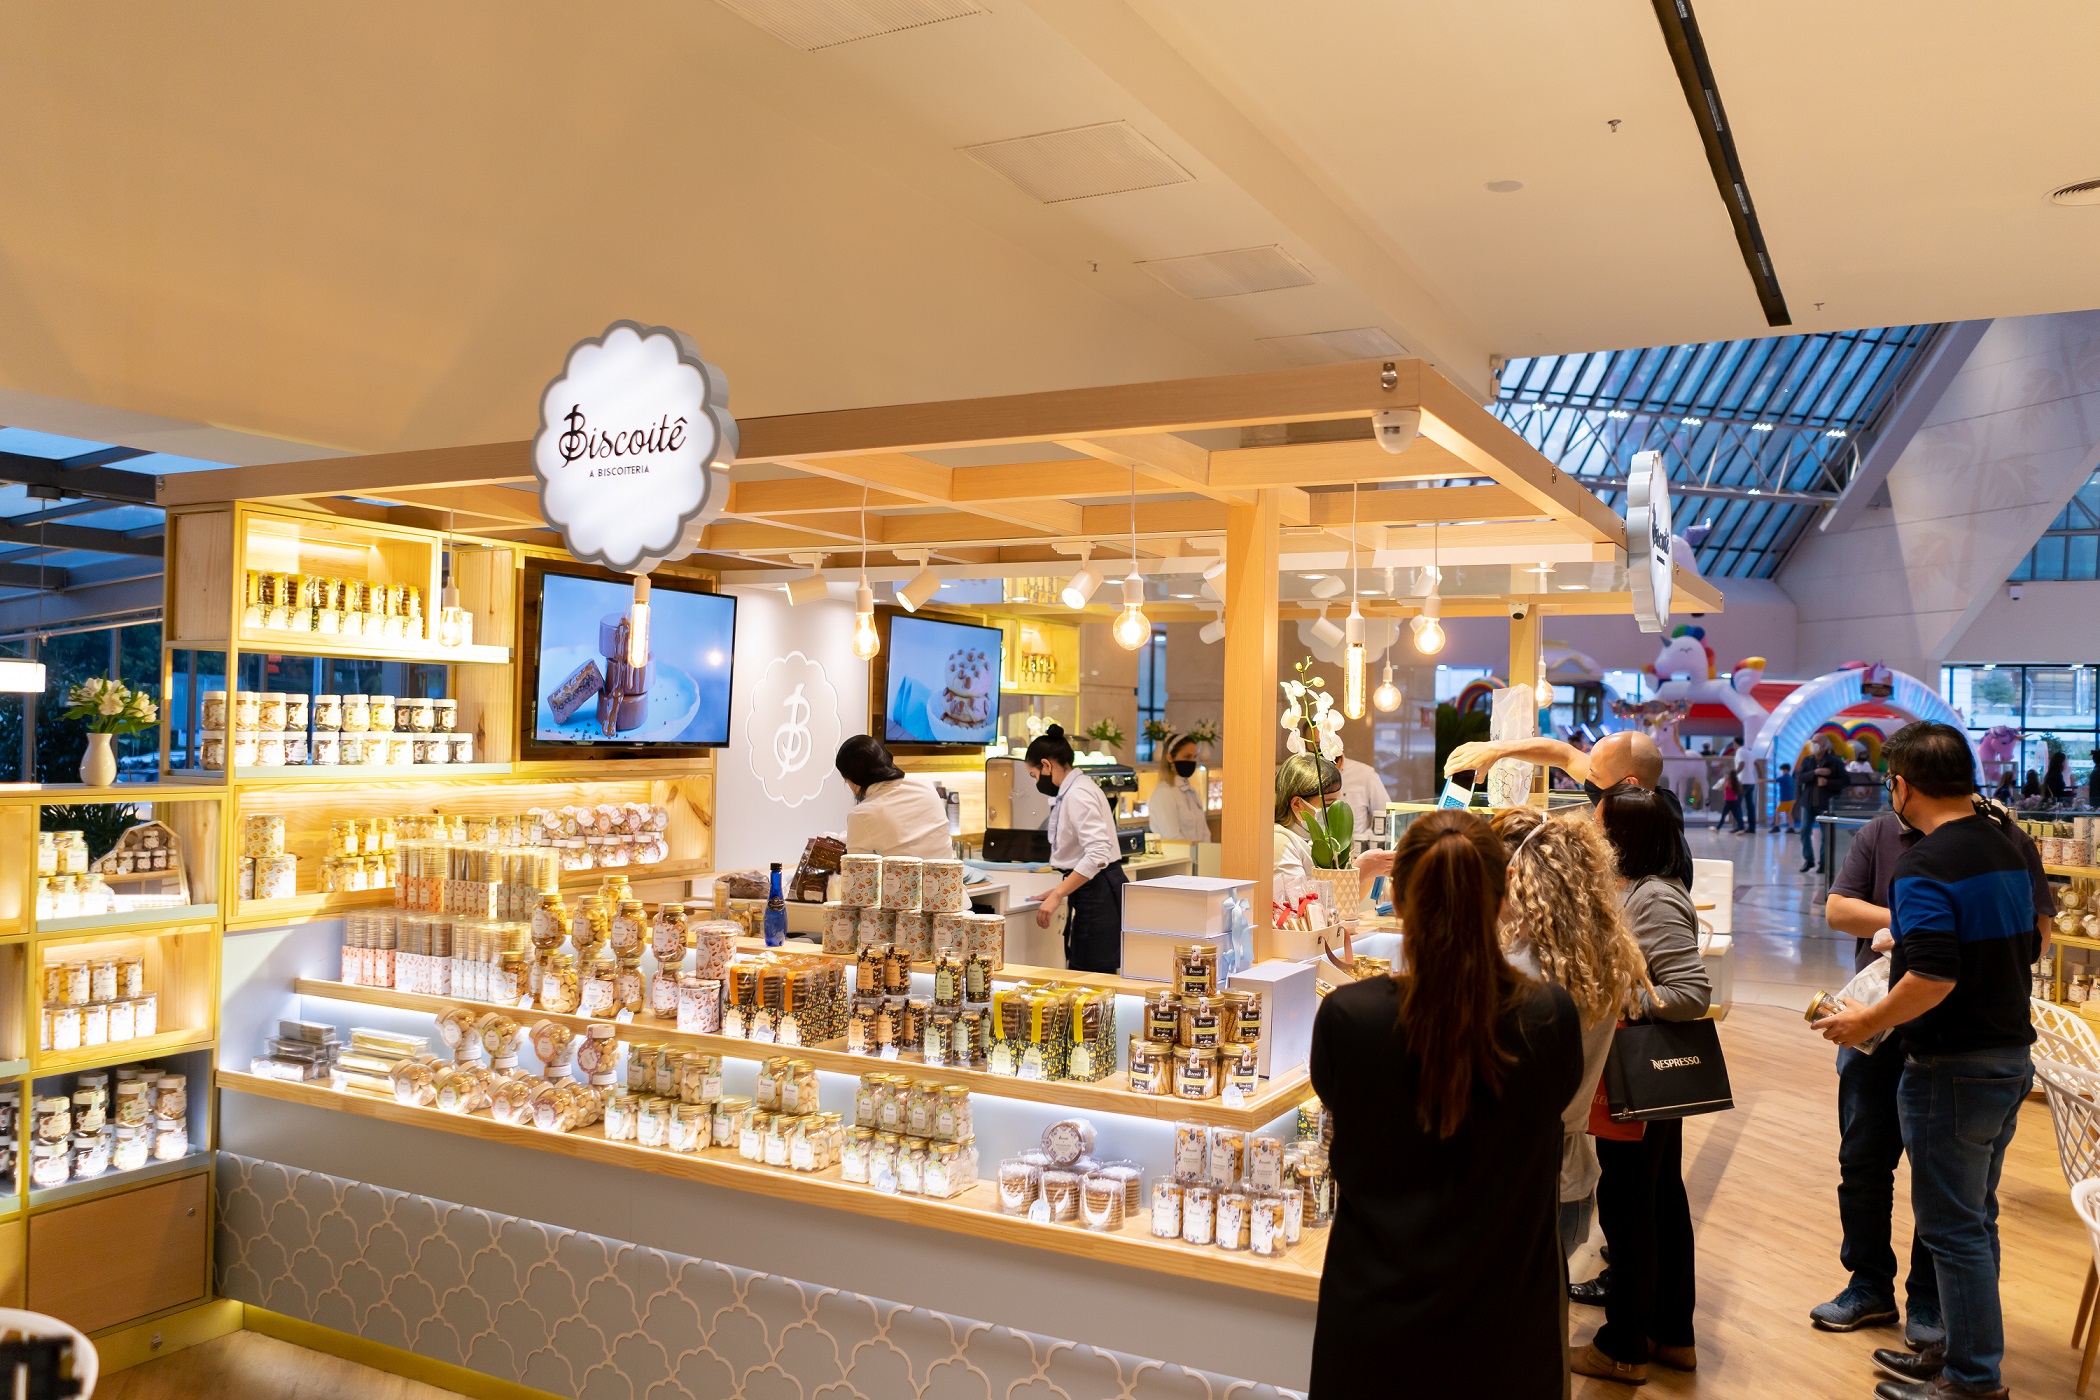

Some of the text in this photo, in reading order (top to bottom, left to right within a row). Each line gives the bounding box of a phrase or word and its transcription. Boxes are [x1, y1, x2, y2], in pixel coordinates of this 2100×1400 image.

[558, 403, 689, 469] Biscoitê
[589, 465, 650, 478] A BISCOITERIA
[1650, 1055, 1700, 1070] NESPRESSO
